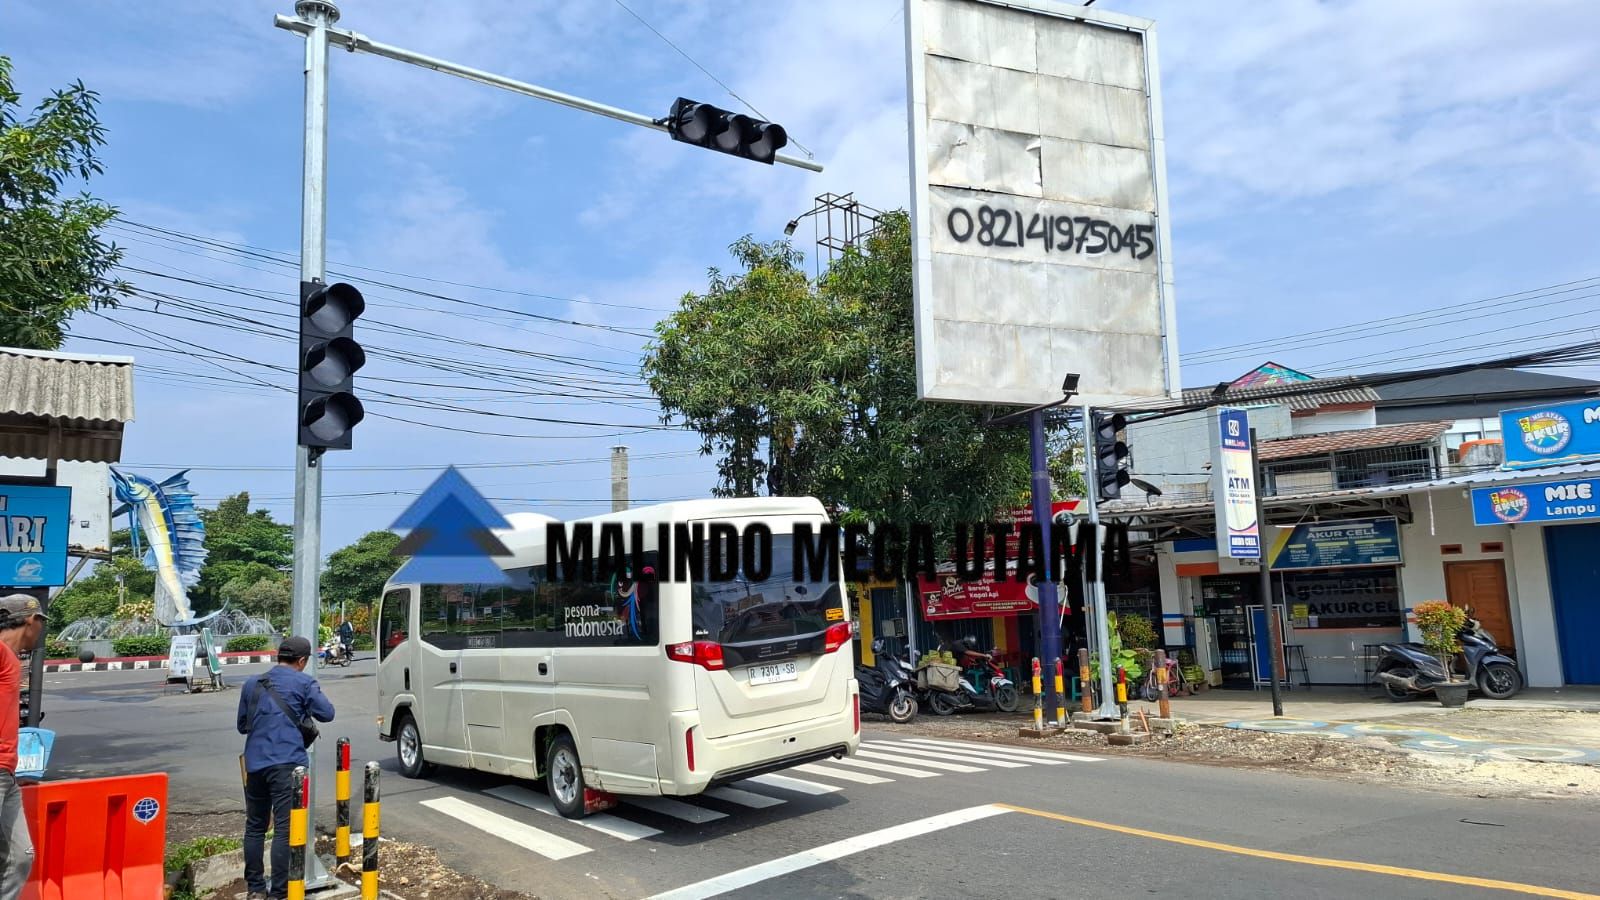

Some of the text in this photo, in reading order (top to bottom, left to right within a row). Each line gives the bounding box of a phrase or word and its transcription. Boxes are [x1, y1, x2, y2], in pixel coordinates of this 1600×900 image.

[947, 205, 1155, 260] 082141975045
[1525, 422, 1569, 443] AKUR
[1228, 477, 1250, 490] ATM
[1544, 483, 1592, 502] MIE
[1546, 504, 1596, 516] Lampu
[1307, 530, 1342, 539] AKUR
[1346, 528, 1379, 536] CELL
[564, 604, 601, 621] pesona
[564, 617, 625, 637] indonesia
[750, 668, 756, 679] R
[760, 664, 780, 678] 7391
[785, 663, 795, 674] SB
